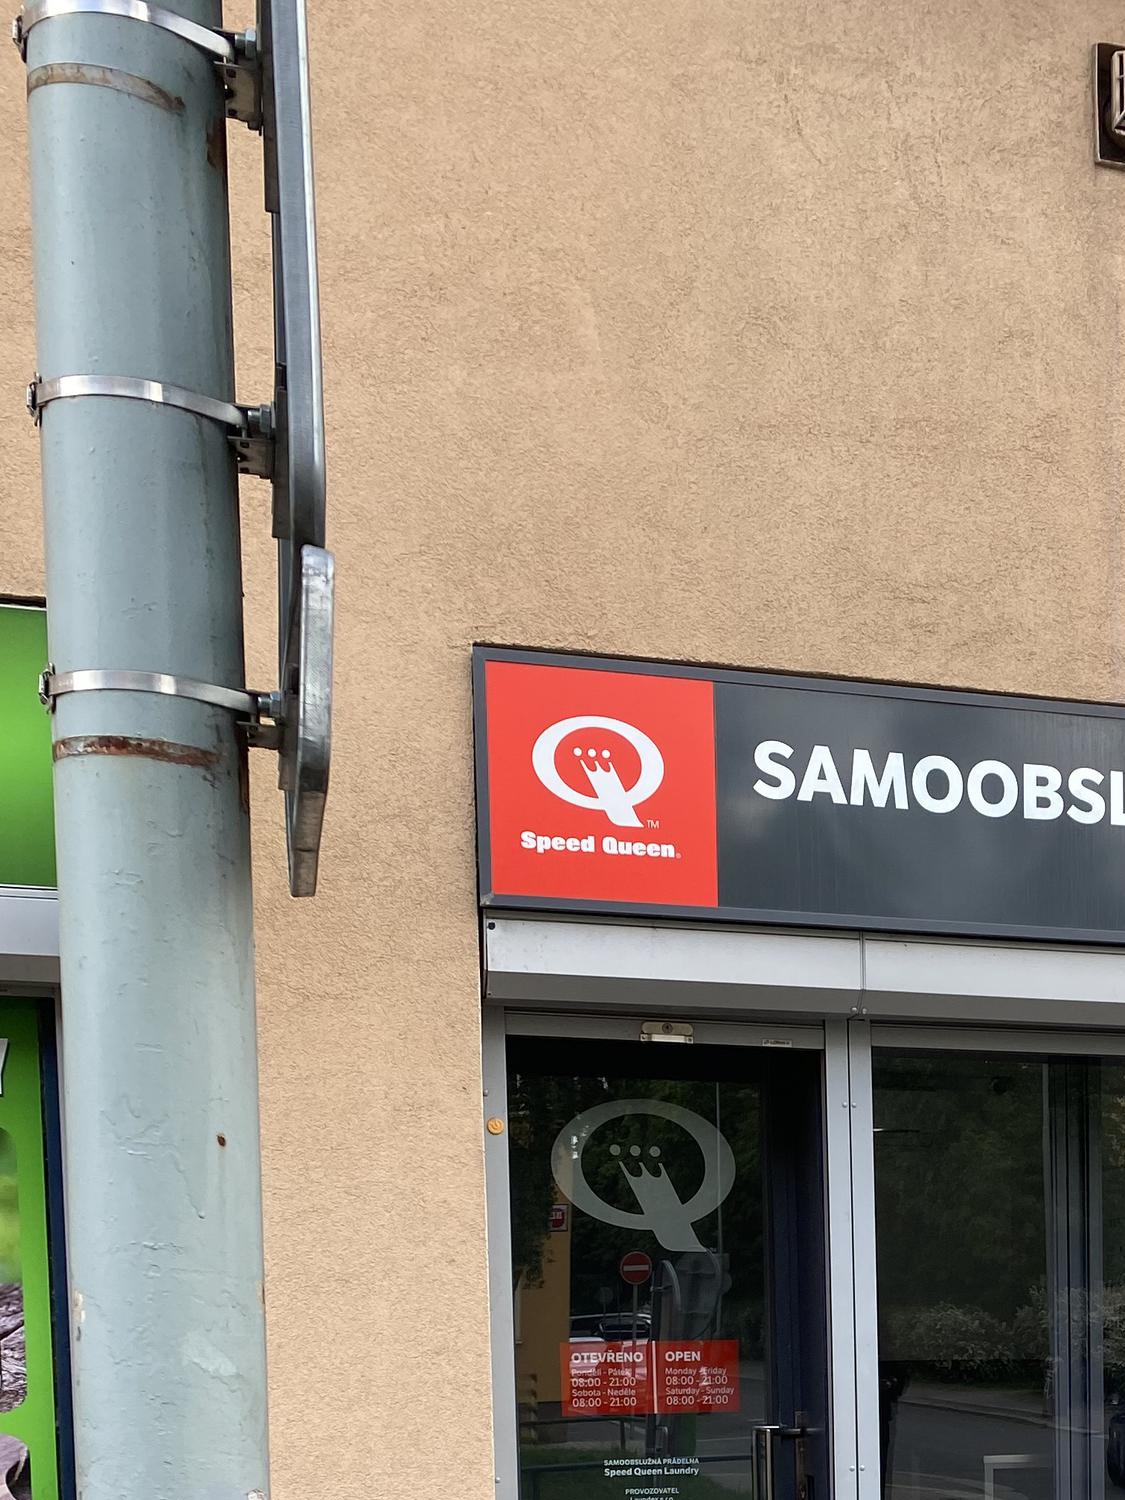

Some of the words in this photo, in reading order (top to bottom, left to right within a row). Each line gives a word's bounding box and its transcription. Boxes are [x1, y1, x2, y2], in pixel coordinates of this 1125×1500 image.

[520, 831, 596, 853] Speed
[602, 836, 676, 858] Queen
[571, 1350, 644, 1363] OTEVŘENO
[665, 1351, 701, 1362] OPEN
[665, 1367, 697, 1376] Monday
[571, 1378, 601, 1387] 08:00
[609, 1377, 636, 1387] 21:00
[665, 1376, 694, 1385] 08:00
[702, 1375, 728, 1385] 21:00
[572, 1388, 601, 1397] Sobota
[665, 1386, 700, 1396] Saturday
[705, 1385, 735, 1395] Sunday
[572, 1397, 602, 1407] 08:00
[609, 1397, 637, 1407] 21:00
[666, 1395, 695, 1405] 08:00
[702, 1394, 729, 1404] 21:00
[603, 1457, 662, 1466] SAMOOBSLUŽNÁ
[662, 1456, 700, 1465] PRÁDELNA
[604, 1468, 632, 1477] Speed
[634, 1467, 662, 1476] Queen
[664, 1466, 699, 1475] Laundry
[625, 1487, 680, 1495] PROVOZOVATEL
